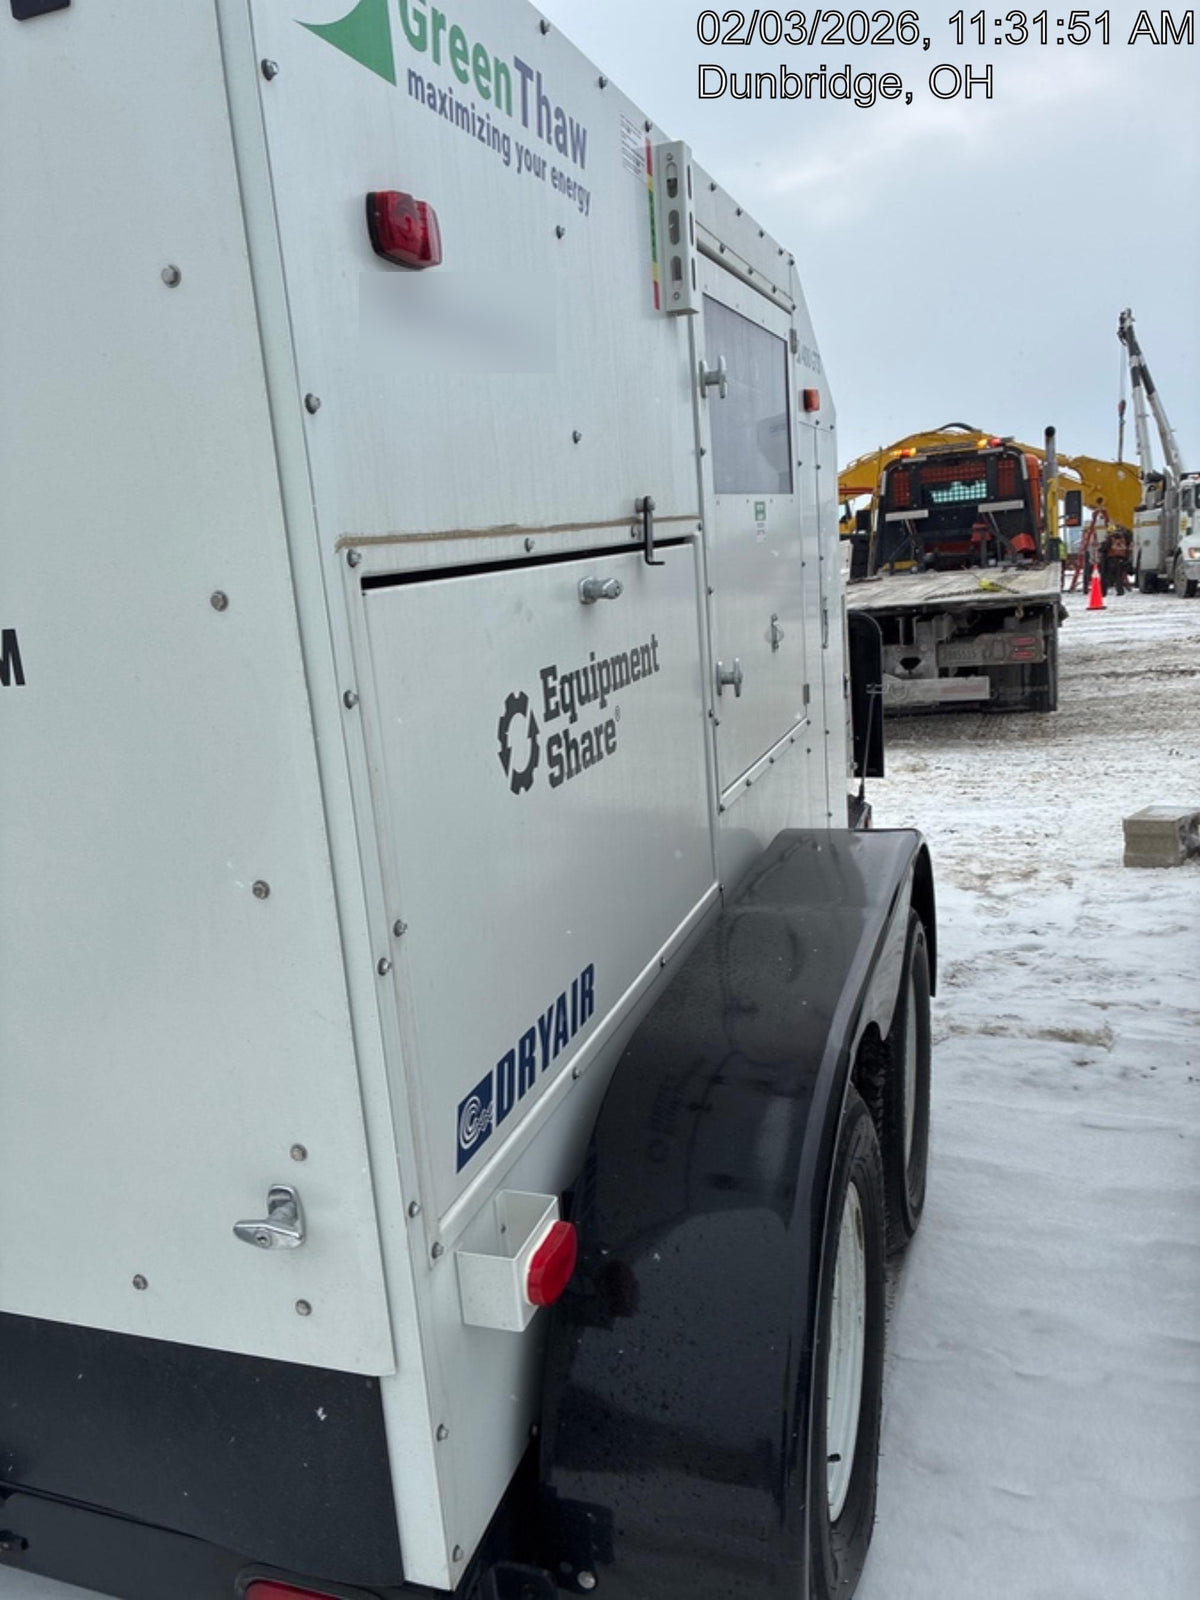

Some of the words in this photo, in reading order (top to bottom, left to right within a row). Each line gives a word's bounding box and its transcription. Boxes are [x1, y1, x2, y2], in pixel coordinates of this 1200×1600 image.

[407, 68, 511, 167] maximizing
[515, 142, 547, 175] your
[551, 163, 591, 216] energy
[539, 633, 660, 725] Equipment
[495, 963, 595, 1128] DRYAIR
